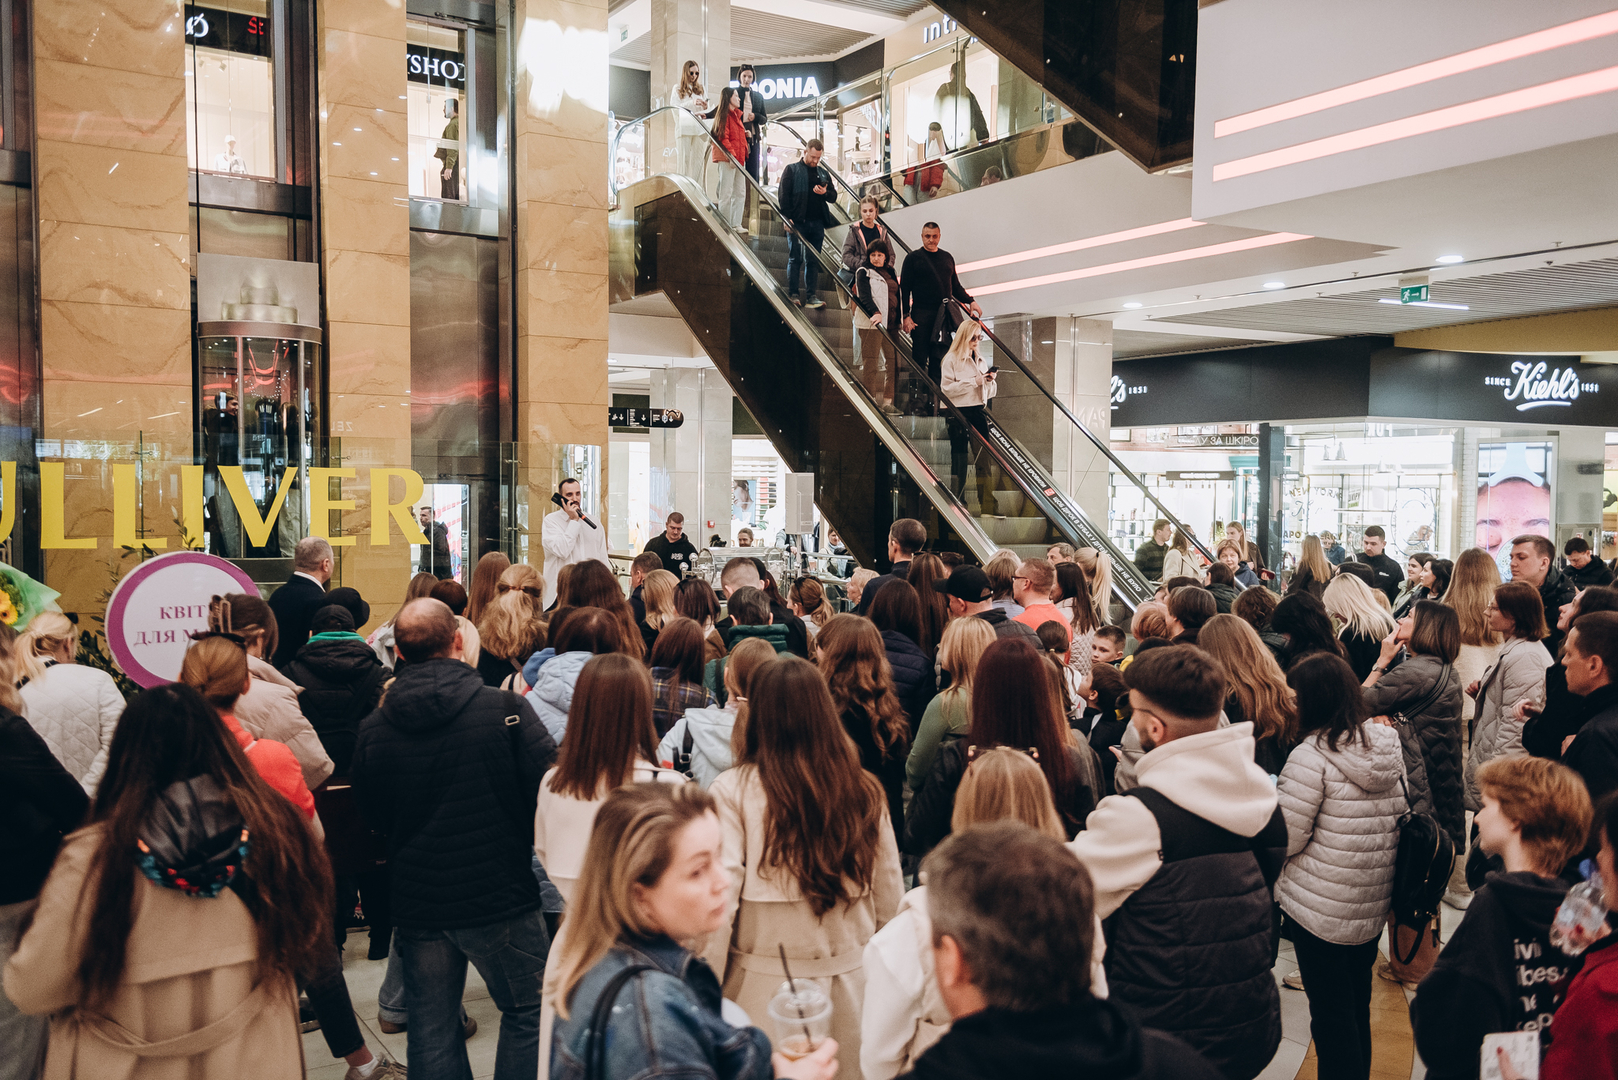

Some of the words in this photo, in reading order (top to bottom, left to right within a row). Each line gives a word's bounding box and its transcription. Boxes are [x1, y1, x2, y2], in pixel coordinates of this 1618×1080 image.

[1503, 360, 1580, 401] Kiehl's
[1580, 383, 1600, 393] 1851
[1128, 386, 1148, 395] 1851
[1210, 436, 1223, 446] ЗА
[1022, 462, 1031, 470] НЕ
[1052, 496, 1065, 509] ЩОБ
[1122, 570, 1131, 578] НЕ
[159, 604, 211, 620] КВІТ
[133, 629, 176, 646] ДЛЯ
